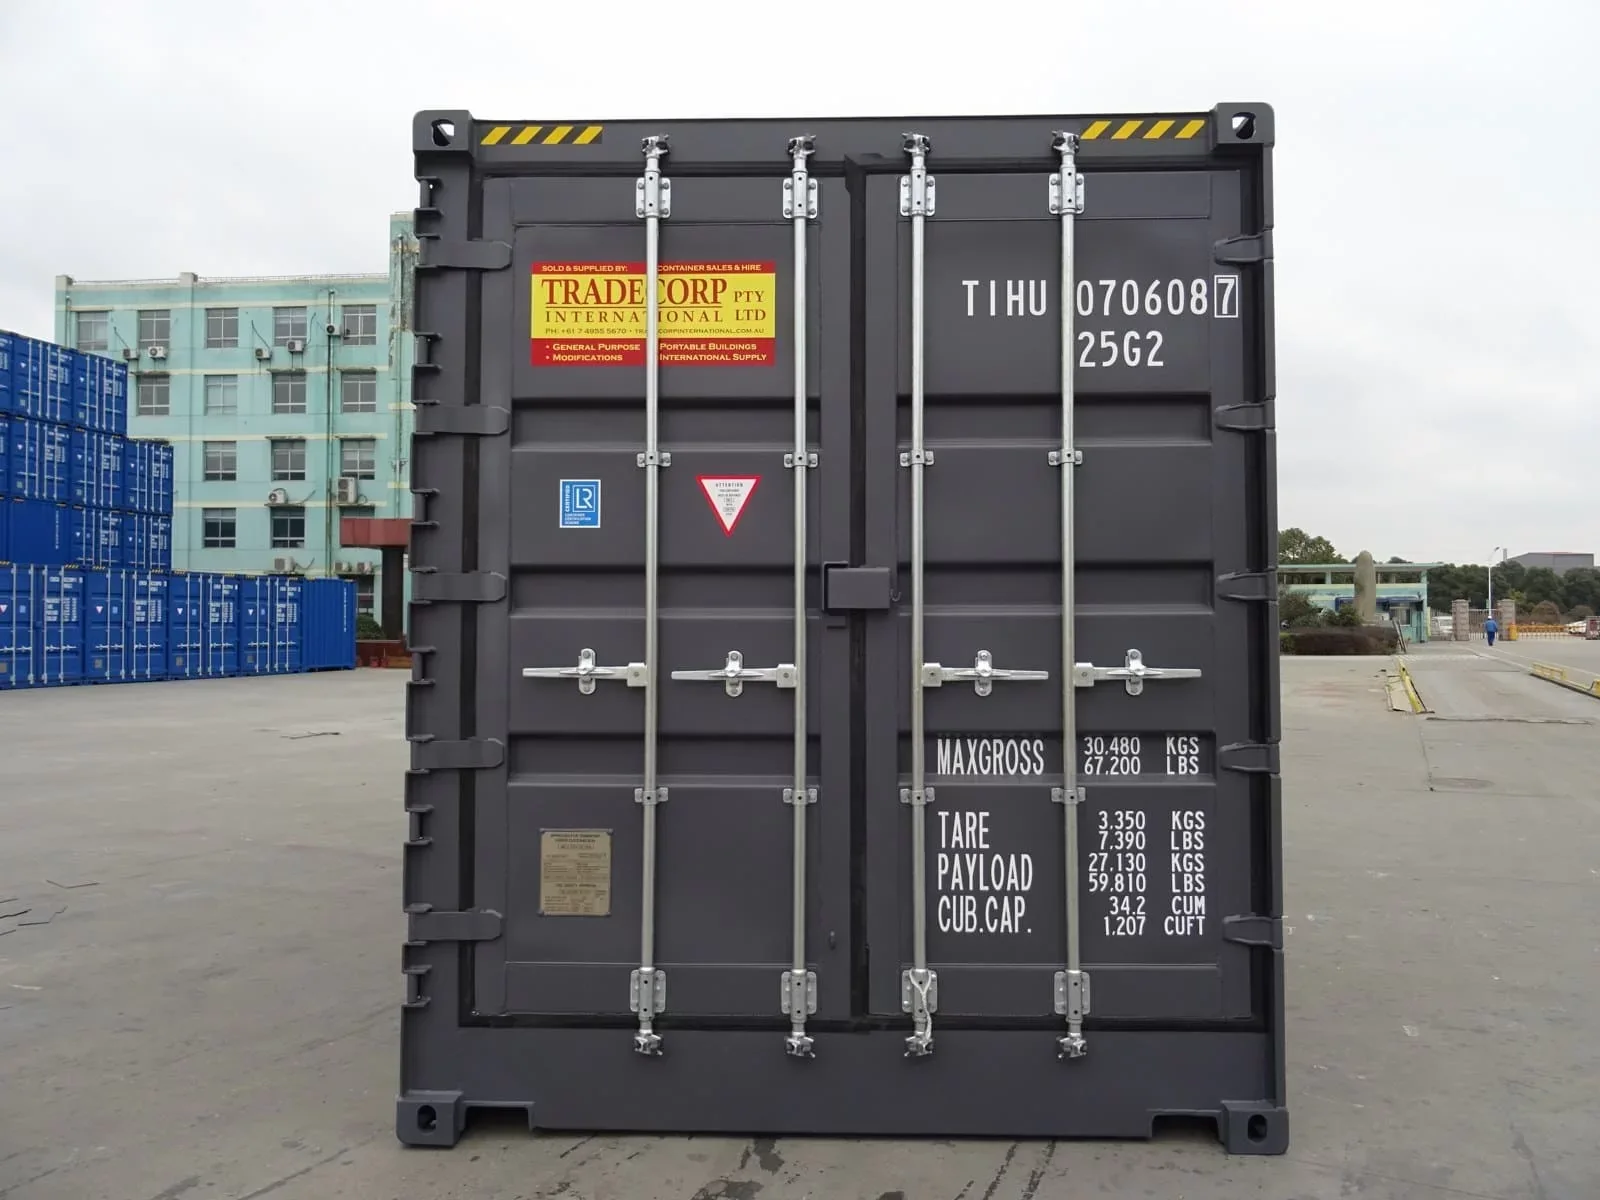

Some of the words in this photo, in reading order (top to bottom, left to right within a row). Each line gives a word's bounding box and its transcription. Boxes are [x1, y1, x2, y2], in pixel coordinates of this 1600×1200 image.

[657, 264, 704, 272] CONTAINER
[734, 290, 765, 303] PTY
[962, 280, 1047, 316] TIHU
[546, 310, 723, 323] INTERNAIONAL
[735, 309, 767, 321] LTD
[552, 343, 596, 351] GENERAL
[598, 343, 641, 351] PURPOSE
[659, 343, 707, 351] PORTABLE
[708, 342, 757, 351] BUILDINGS
[1077, 330, 1164, 367] 25G2
[733, 353, 767, 361] SUPPLY
[937, 739, 1044, 775] MAXGROSS
[1166, 737, 1199, 755] KGS
[1166, 756, 1199, 775] LBS
[938, 811, 990, 849] TARE
[1171, 811, 1205, 830] KGS
[1171, 831, 1204, 850] LBS
[938, 853, 1033, 891] PAYLOAD
[1171, 853, 1205, 872] KGS
[1171, 873, 1204, 892] LBS
[1109, 896, 1146, 915] 34.2
[1171, 896, 1205, 915] CUM
[1164, 916, 1205, 936] CUFT
